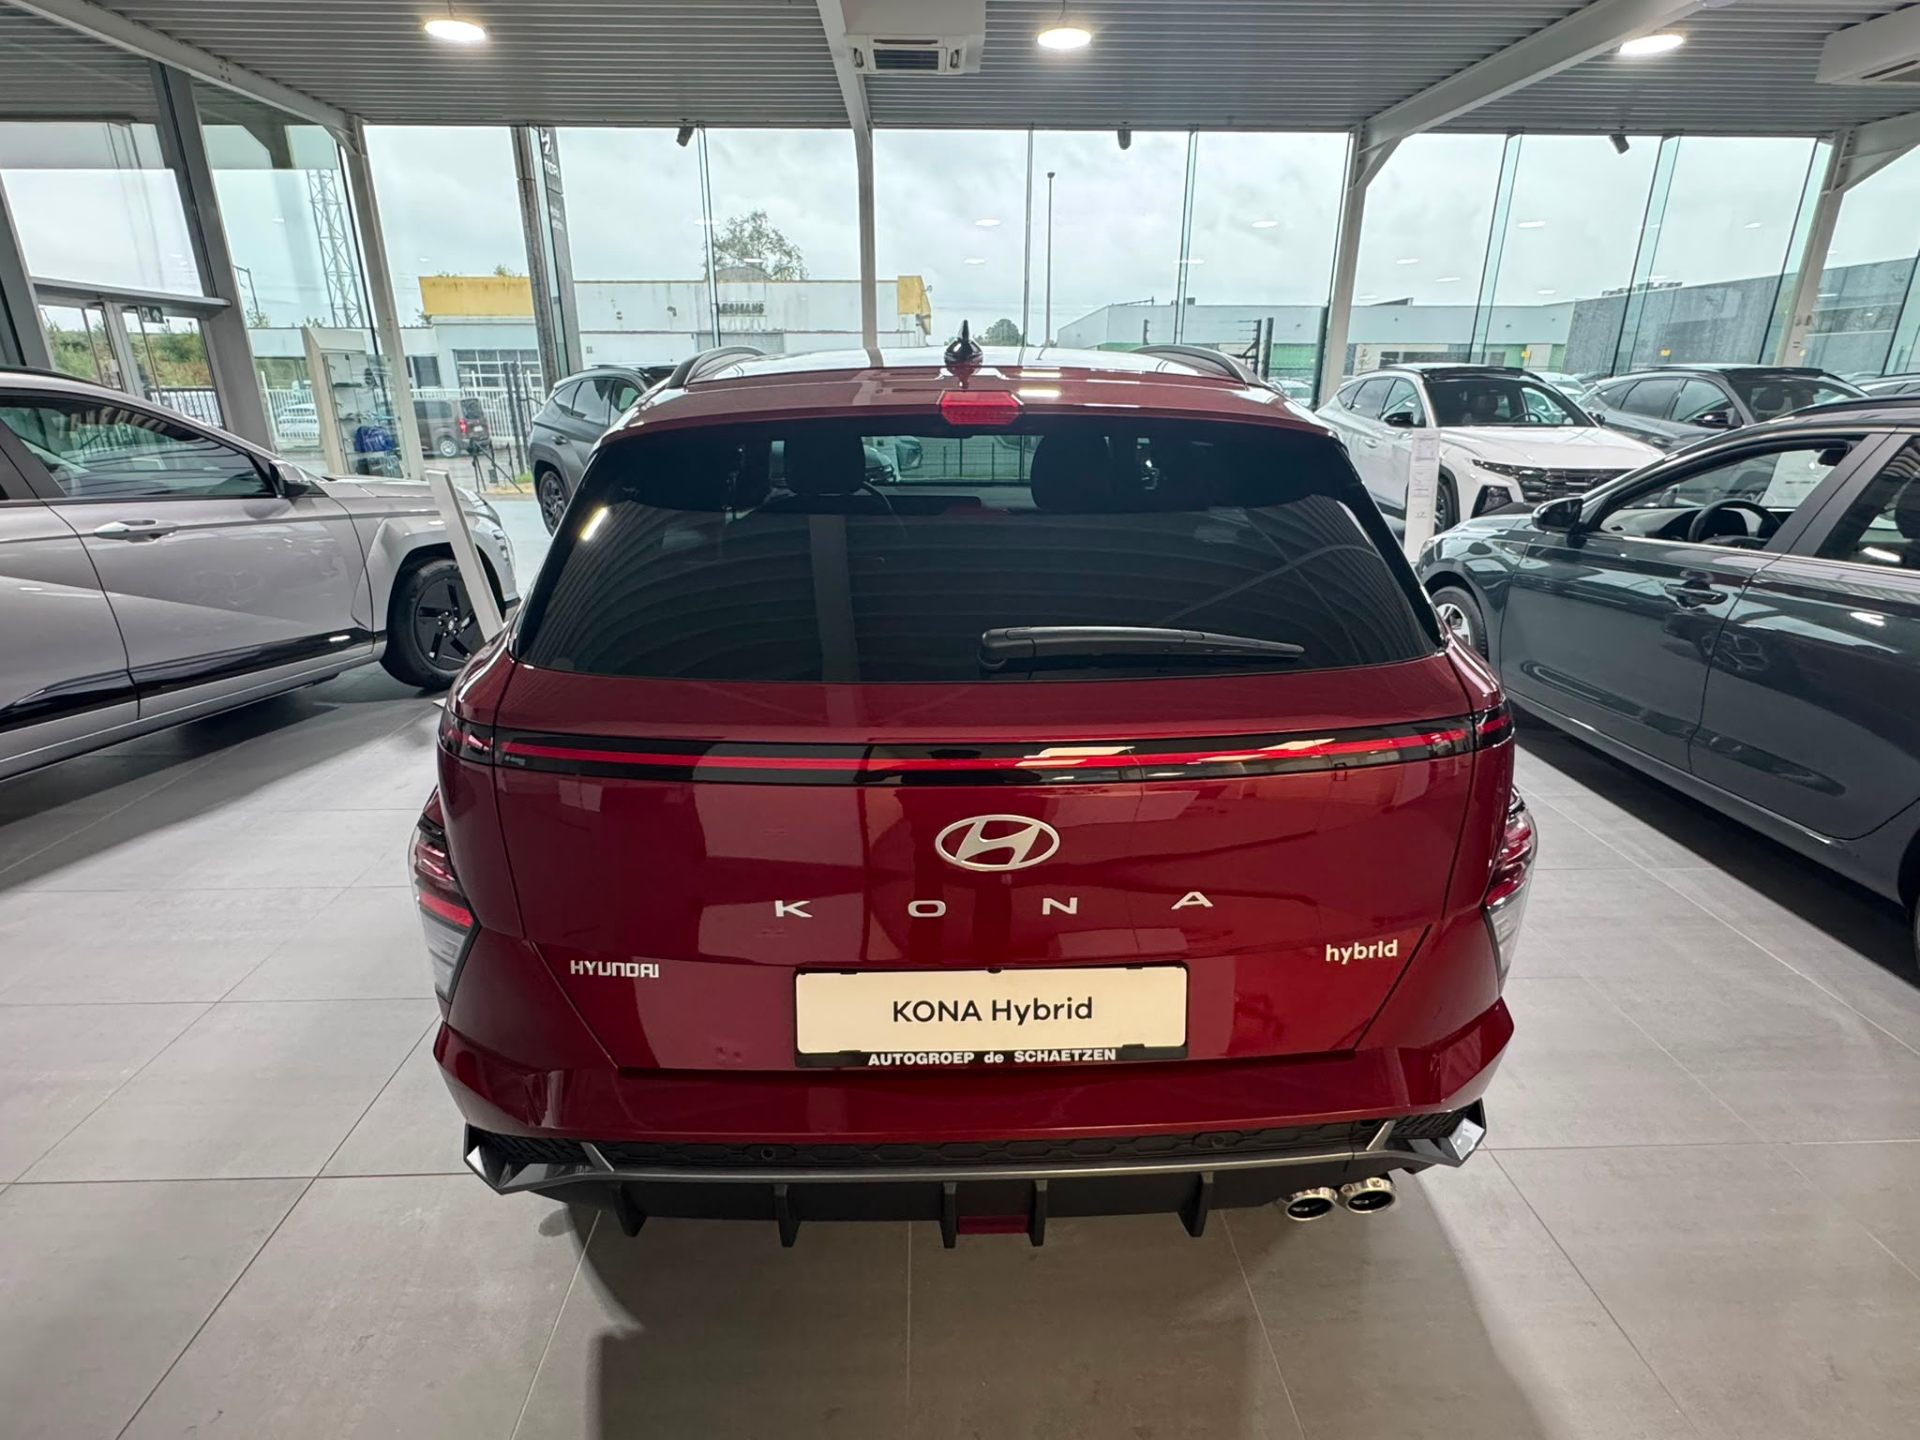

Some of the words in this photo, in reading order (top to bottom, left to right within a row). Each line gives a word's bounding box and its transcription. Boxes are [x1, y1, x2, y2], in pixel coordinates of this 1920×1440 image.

[719, 303, 764, 314] ESMANS
[774, 891, 1214, 918] KONA
[1325, 939, 1398, 965] hybrid
[570, 959, 660, 978] HYUNDAI
[893, 1000, 983, 1023] KONA
[991, 996, 1093, 1026] Hybrid
[868, 1052, 975, 1066] AUTOGROEP
[983, 1051, 1004, 1064] de
[1013, 1048, 1117, 1064] SCHAETZEN
